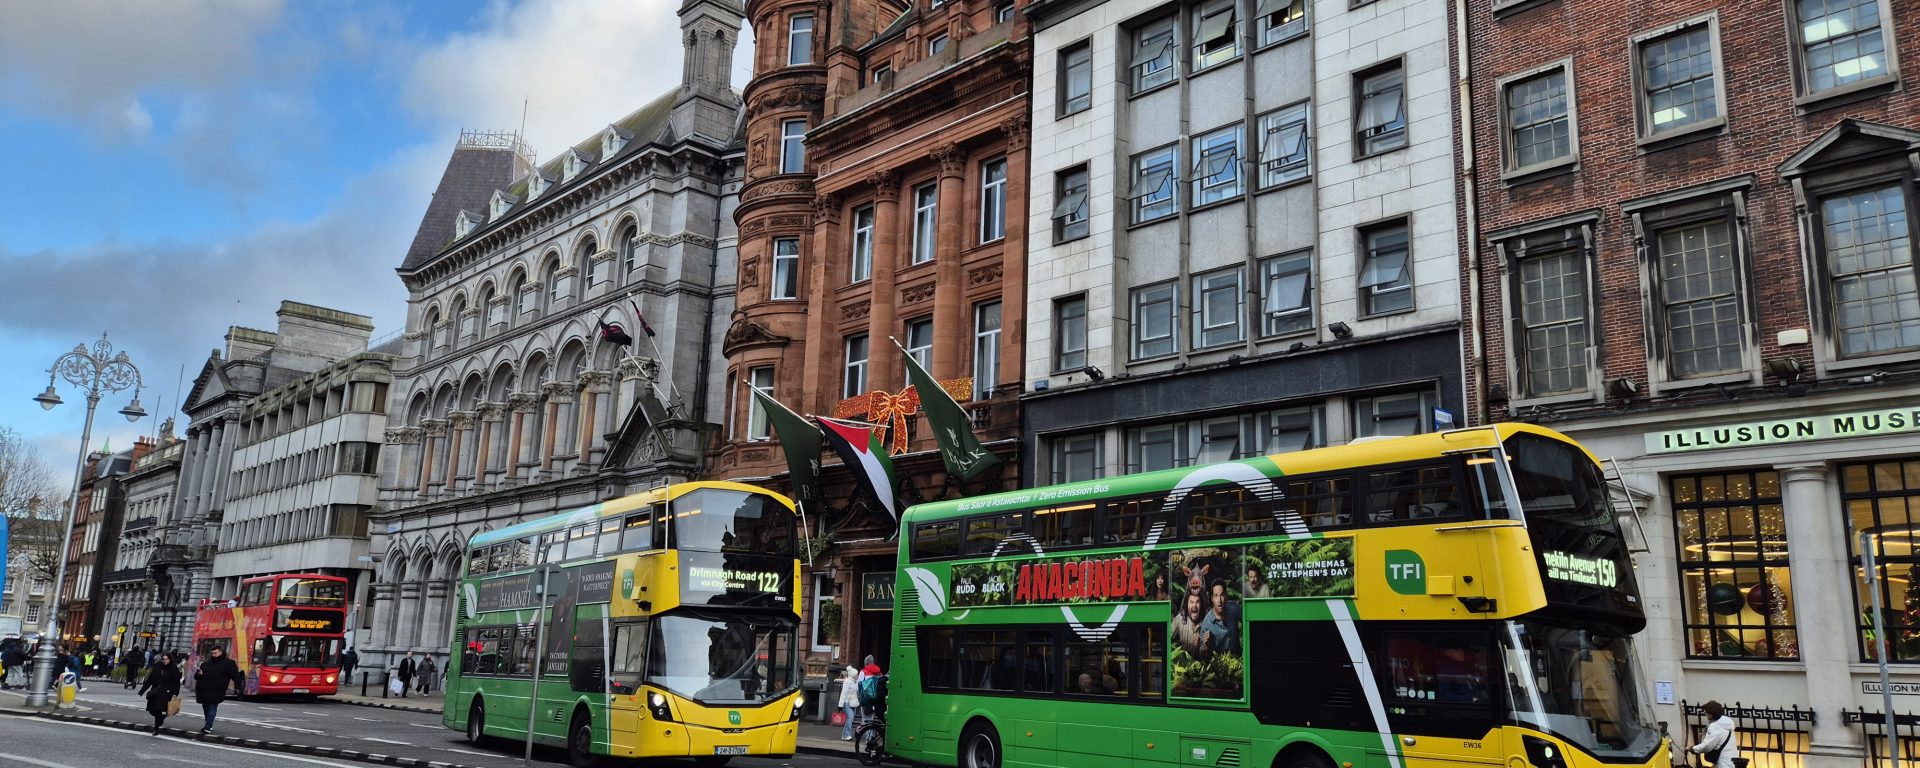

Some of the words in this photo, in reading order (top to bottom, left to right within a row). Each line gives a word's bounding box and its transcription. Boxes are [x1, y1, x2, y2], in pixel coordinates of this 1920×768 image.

[1663, 420, 1815, 449] ILLUSION
[957, 503, 970, 511] Bus
[1039, 490, 1056, 500] Zero
[1057, 485, 1093, 498] Emission
[1094, 483, 1110, 493] Bus
[1270, 562, 1292, 571] ONLY
[1294, 561, 1303, 569] IN
[1305, 559, 1345, 569] CINEMAS
[1569, 554, 1597, 573] Avenue
[1596, 558, 1617, 588] 150
[1267, 571, 1280, 579] ST.
[1281, 568, 1328, 578] STEPHEN'S
[1330, 567, 1348, 576] DAY
[1389, 563, 1421, 580] TFI
[1560, 571, 1569, 581] na
[623, 578, 634, 590] TFI
[689, 567, 734, 582] Drimnagh
[735, 570, 757, 582] Road
[757, 571, 780, 593] 122
[711, 580, 724, 588] City
[724, 581, 746, 589] Centre
[960, 577, 972, 585] PAUL
[988, 575, 1001, 584] JACK
[1016, 556, 1147, 601] ANACONDA
[956, 584, 976, 594] RUDD
[982, 582, 1005, 593] BLACK
[1463, 741, 1483, 749] EW36
